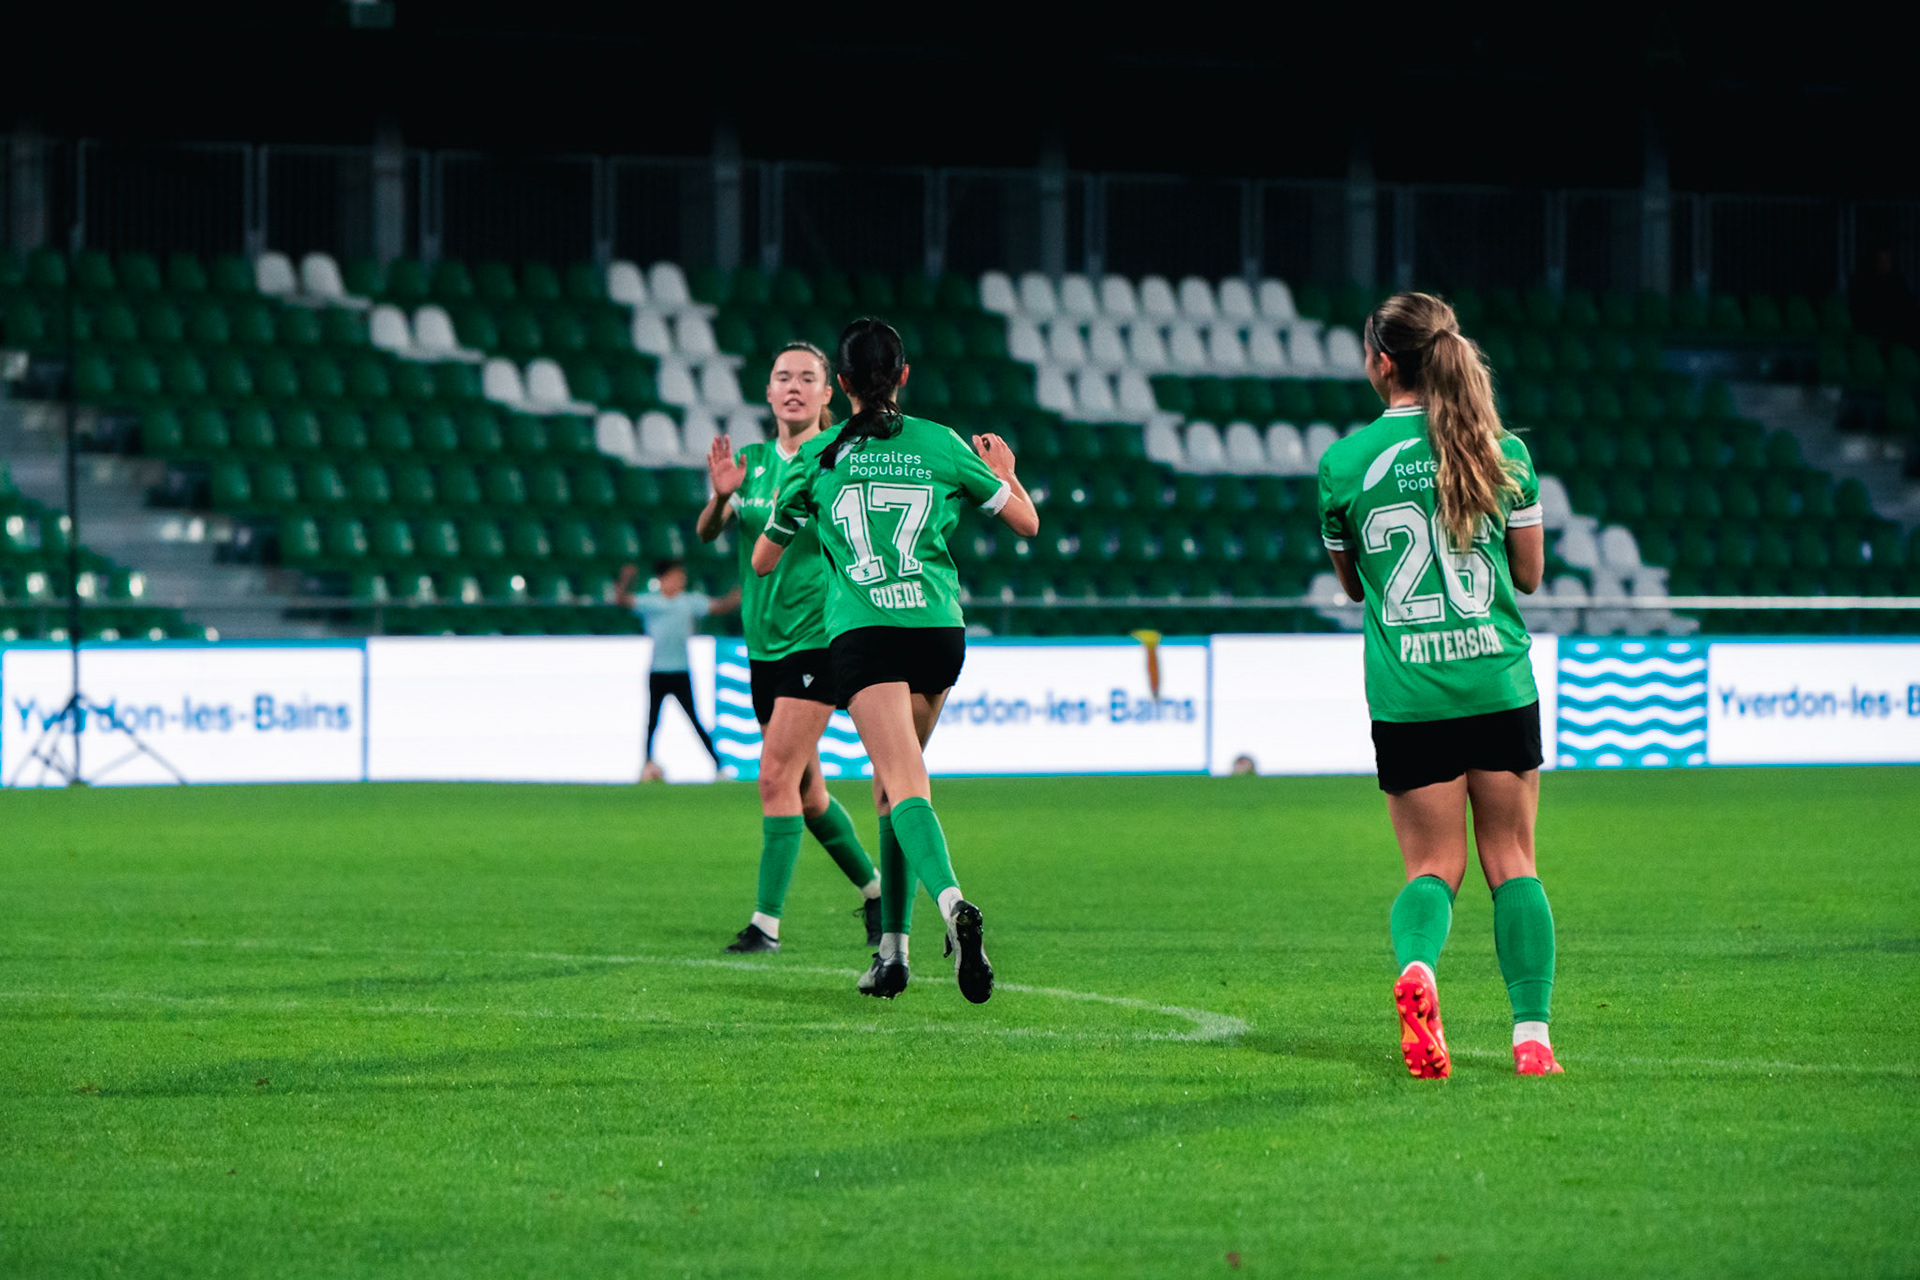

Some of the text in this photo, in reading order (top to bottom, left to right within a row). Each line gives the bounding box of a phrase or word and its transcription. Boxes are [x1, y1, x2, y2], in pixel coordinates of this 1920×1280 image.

[850, 451, 921, 464] Retraites
[850, 464, 932, 480] Populaires
[1394, 460, 1438, 478] Retra
[831, 481, 934, 585] 17
[1361, 501, 1495, 627] 26
[869, 580, 927, 609] GUEDE
[1400, 624, 1504, 664] PATTERSON
[939, 688, 1196, 724] erdon-les-Bains
[1717, 683, 1920, 719] Yverdon-les-B
